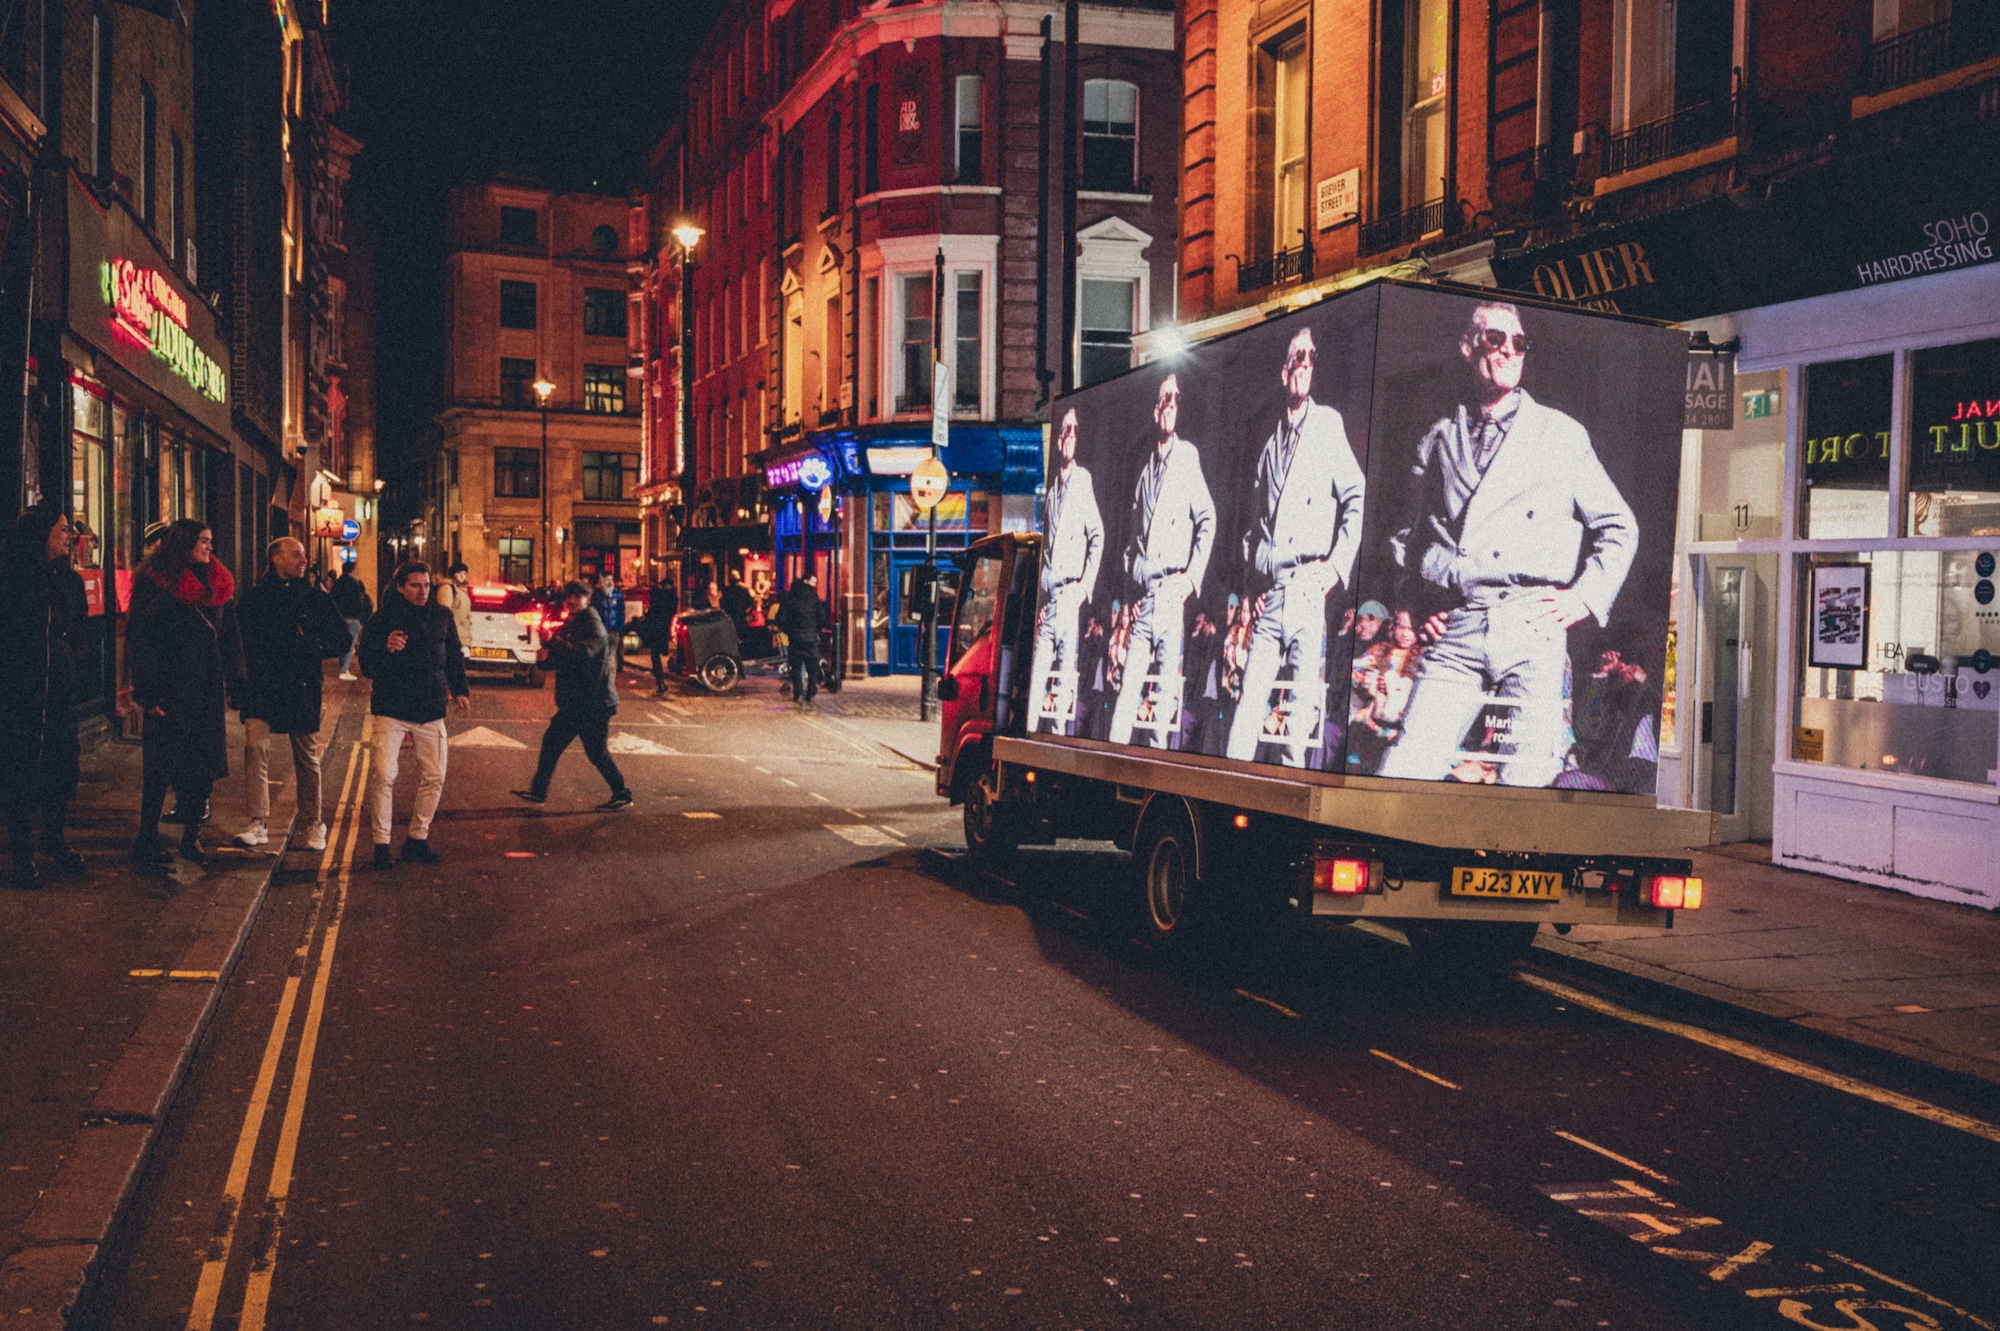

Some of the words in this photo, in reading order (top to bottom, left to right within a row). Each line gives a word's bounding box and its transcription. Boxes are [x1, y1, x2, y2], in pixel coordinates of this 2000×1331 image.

[901, 101, 916, 112] AD
[1321, 194, 1343, 213] STREET
[1344, 190, 1355, 204] W1
[1923, 212, 1989, 247] SOHO
[1857, 237, 1993, 284] HAIRDRESSING
[1733, 504, 1748, 528] 11
[1904, 671, 1970, 695] GUSTO
[1461, 870, 1512, 893] PJ23
[1517, 876, 1556, 896] XVY
